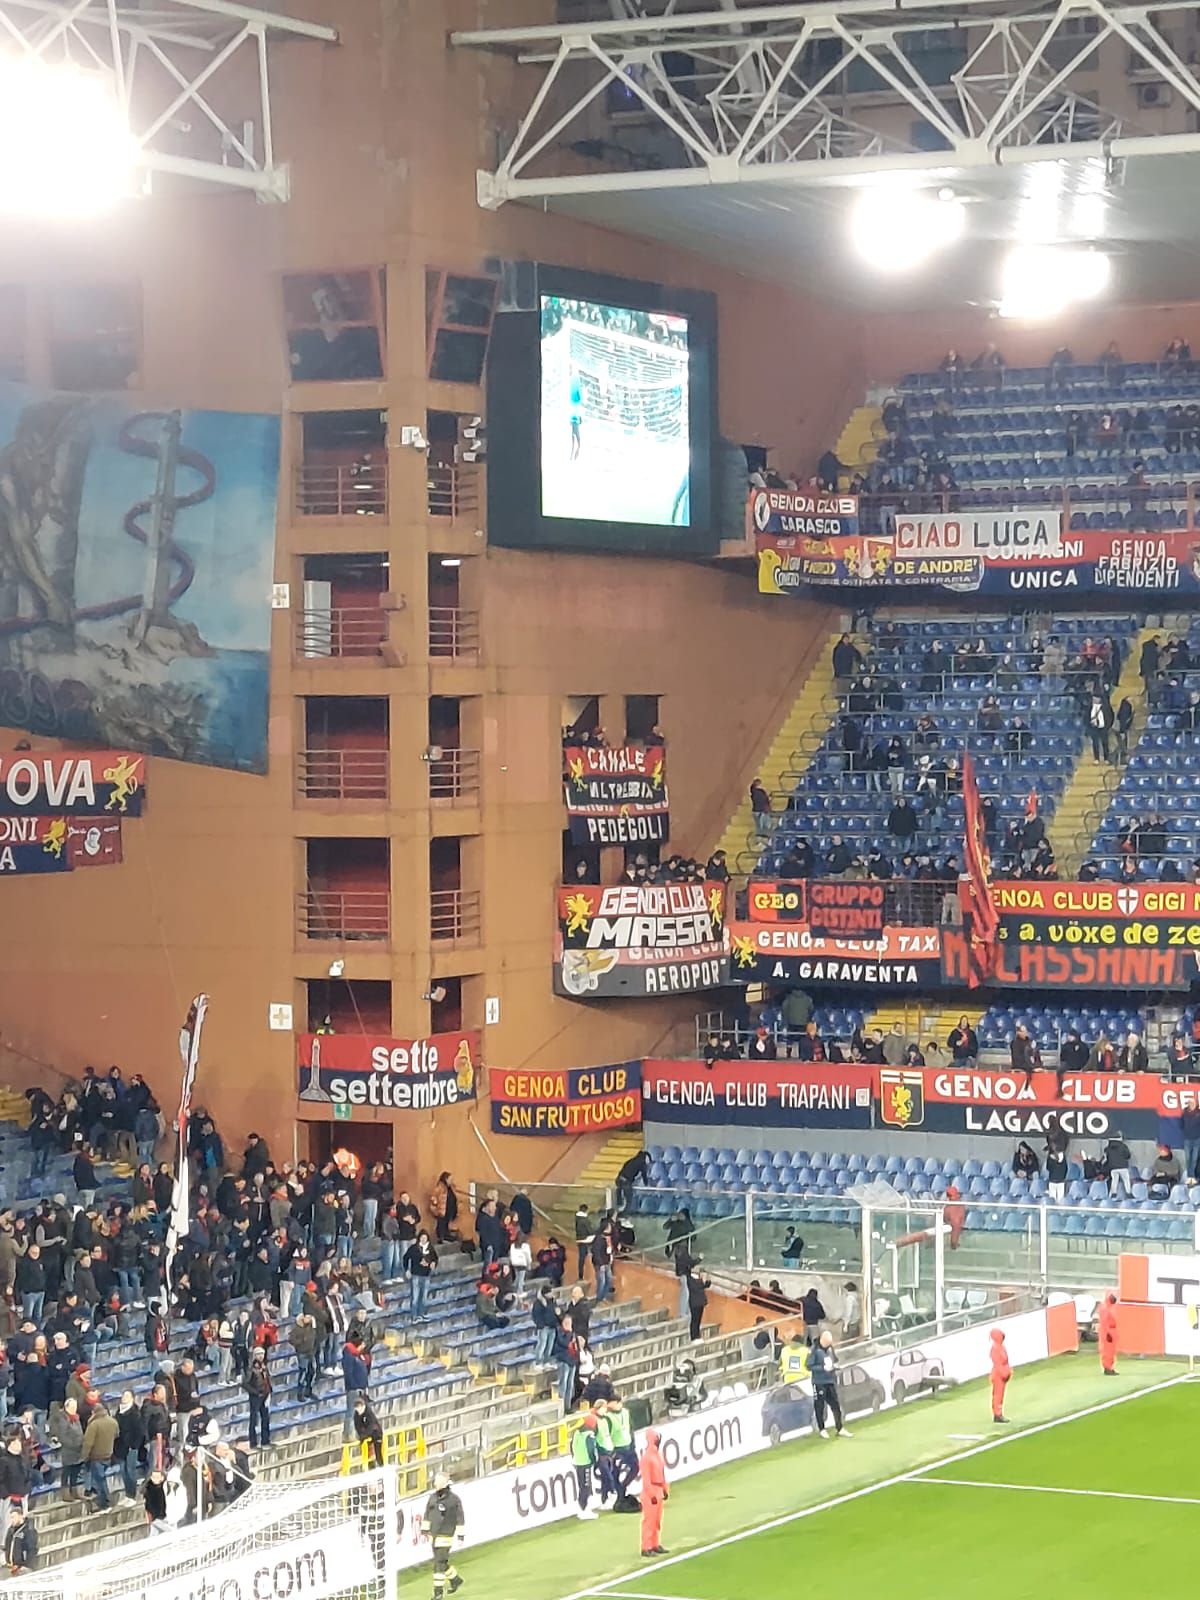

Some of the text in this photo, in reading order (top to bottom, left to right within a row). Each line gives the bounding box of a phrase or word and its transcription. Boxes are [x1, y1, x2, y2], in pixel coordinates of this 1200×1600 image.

[770, 493, 857, 514] GENOA CLUB
[780, 515, 841, 535] CARASCO
[898, 519, 1048, 548] CIAO LUCA
[1111, 540, 1166, 558] GENOA
[894, 561, 915, 574] DE
[1010, 568, 1078, 588] UNICA
[587, 815, 663, 842] PEDEGOLI
[599, 885, 708, 915] GENOA CLUB
[754, 892, 799, 909] GEO
[811, 885, 884, 906] GRUPPO
[1053, 891, 1113, 911] CLUB
[1144, 892, 1186, 911] GIGI
[586, 914, 715, 948] MASSA
[758, 931, 826, 950] GENOA
[1123, 922, 1160, 945] de
[943, 930, 1176, 985] MLASSANA
[772, 961, 918, 983] A. GARAVENTA
[372, 1040, 439, 1073] sette
[330, 1073, 458, 1109] settembre
[504, 1068, 627, 1099] GENOA CLUB
[656, 1080, 851, 1110] GENOA CLUB TRAPANI
[934, 1074, 1136, 1103] GENOA CLUB
[500, 1096, 635, 1129] SAN FRUTTUOSO
